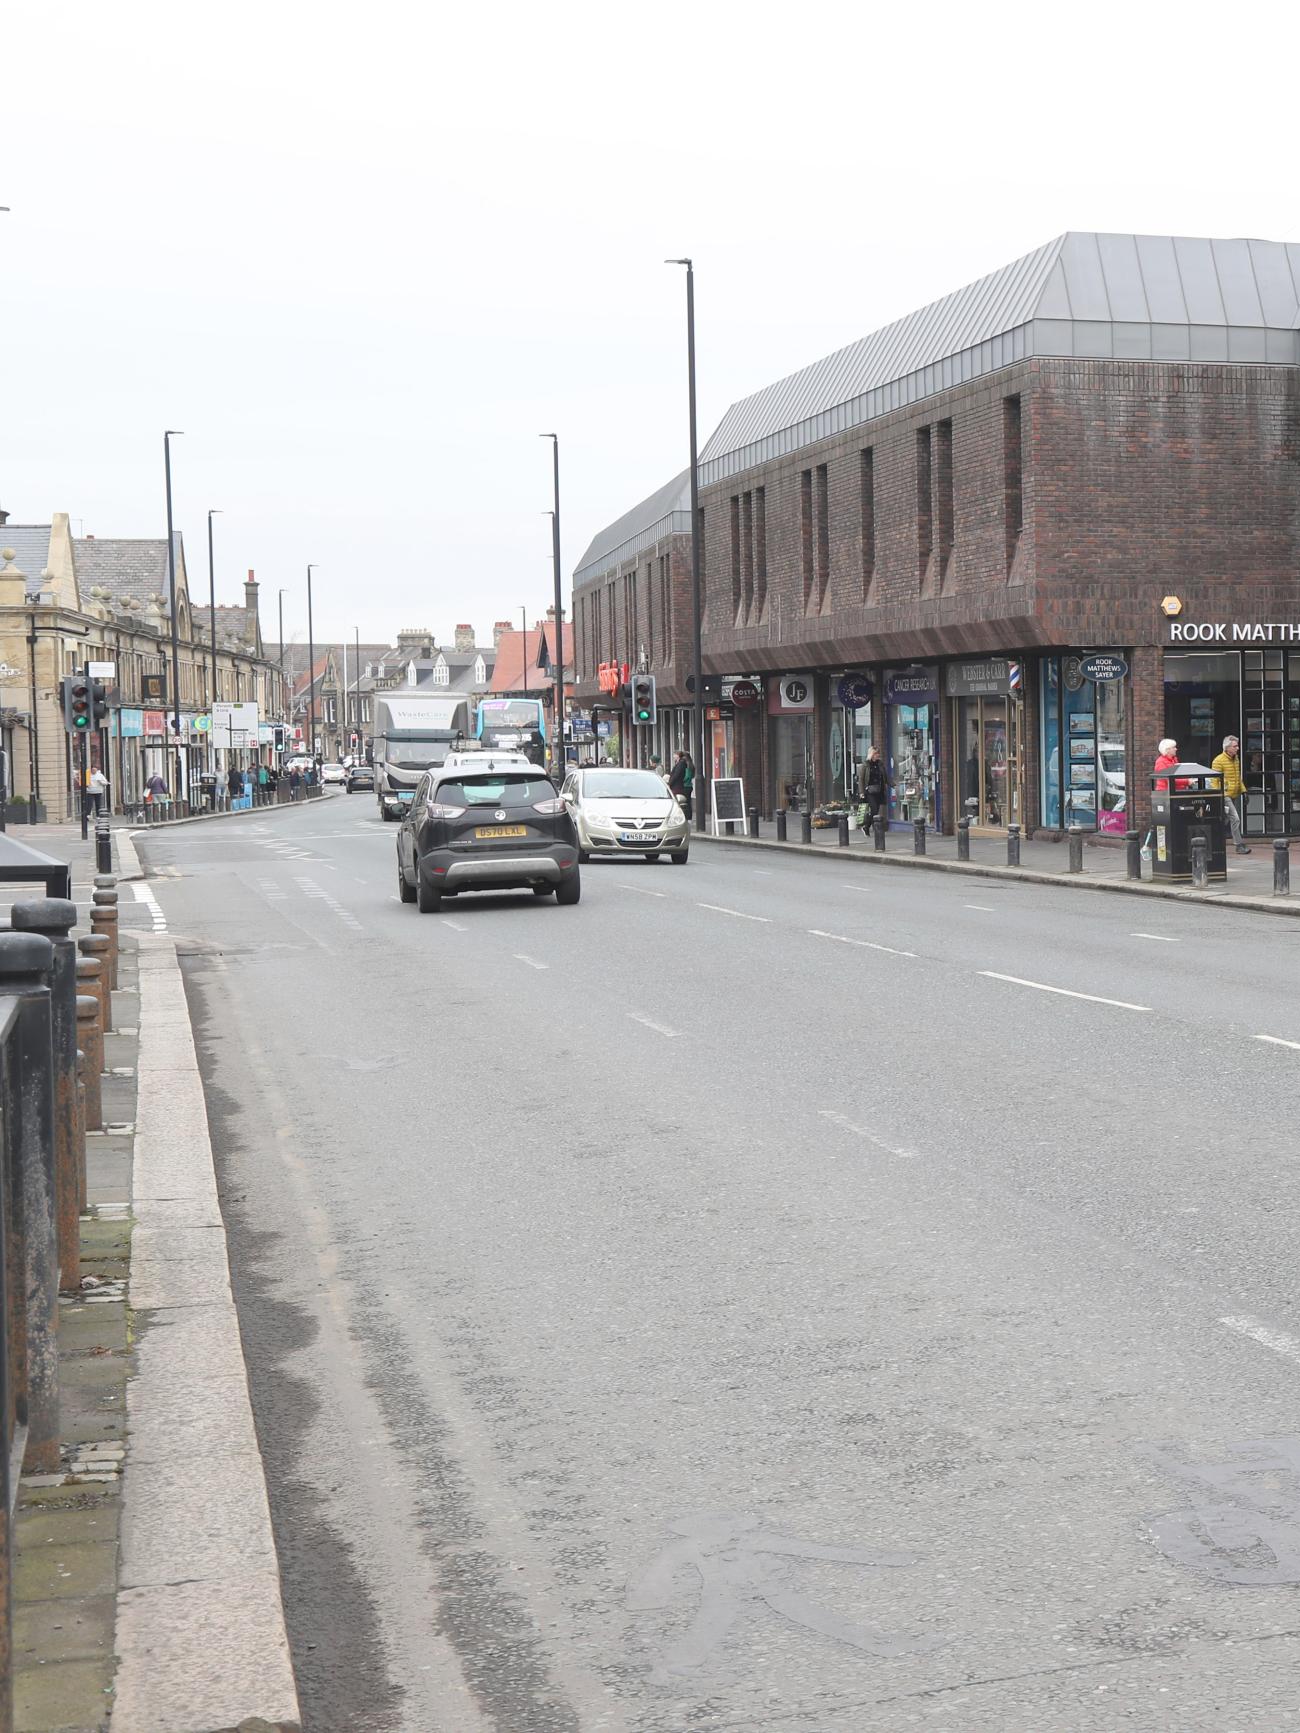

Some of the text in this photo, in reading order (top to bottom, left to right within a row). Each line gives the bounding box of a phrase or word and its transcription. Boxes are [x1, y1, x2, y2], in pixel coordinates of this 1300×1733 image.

[1170, 623, 1228, 641] ROOK
[962, 663, 986, 681] WEBSTER
[991, 662, 1006, 679] CARR
[894, 678, 909, 692] CANCER
[910, 678, 929, 691] RESEARCH
[734, 688, 756, 697] COSTA
[480, 825, 522, 837] DS70 LXL
